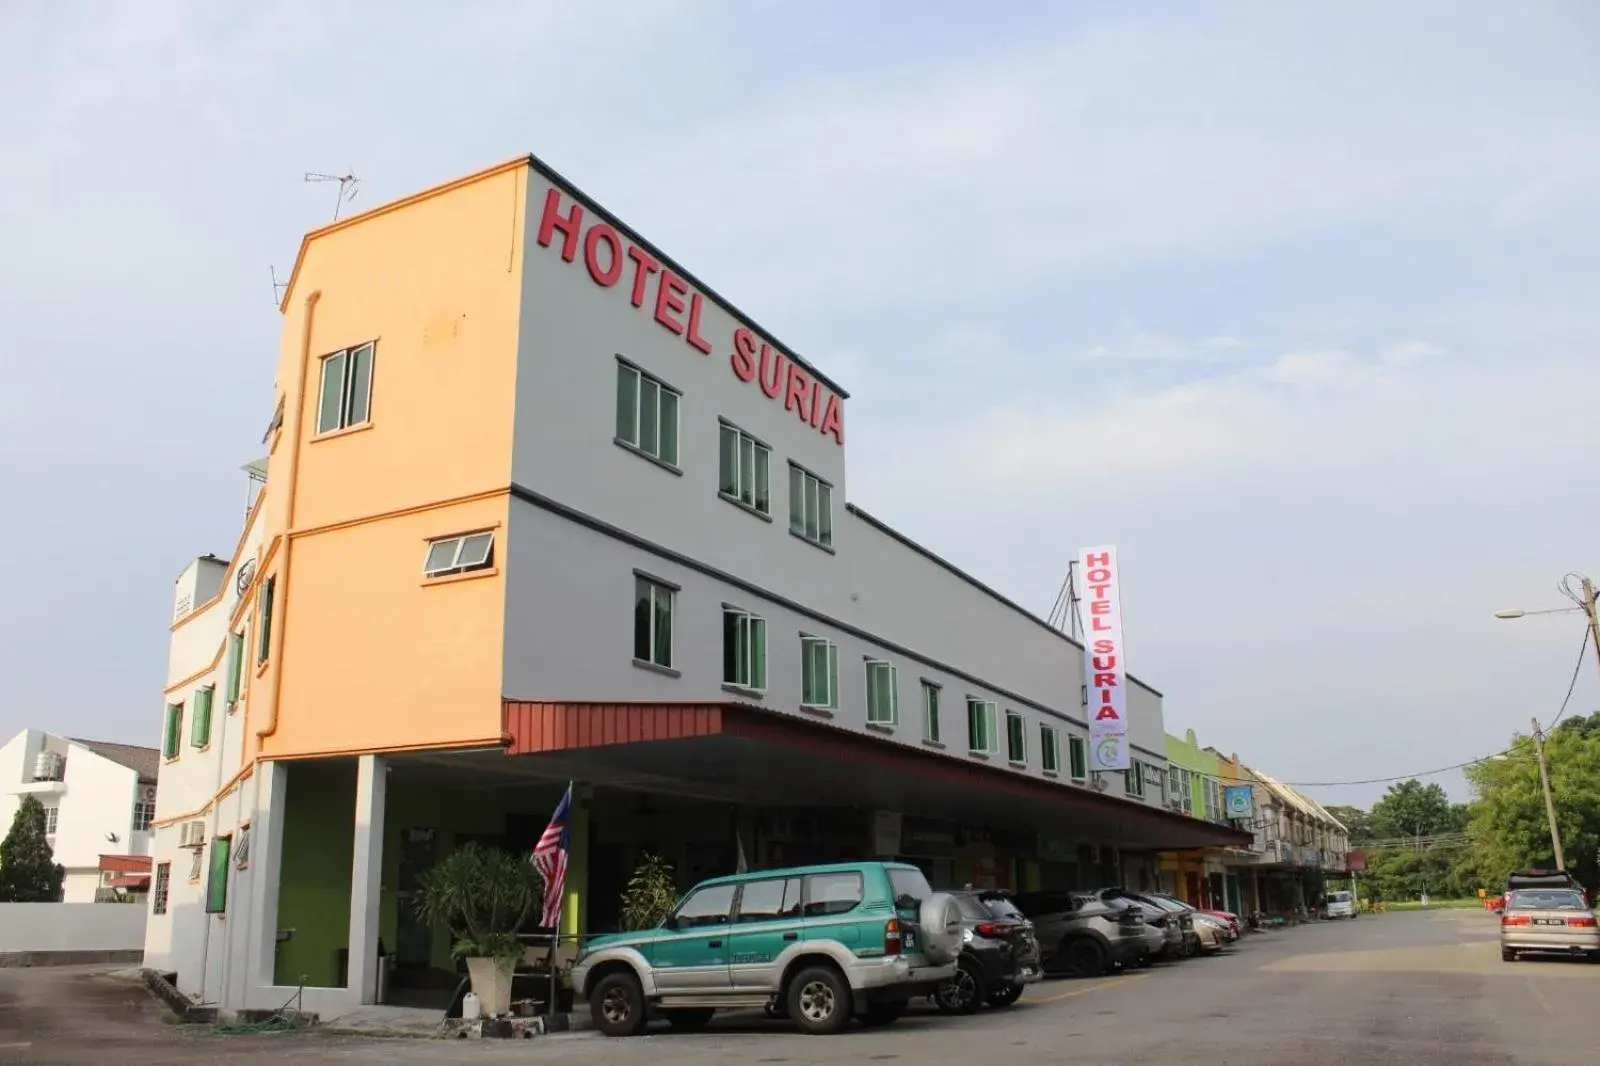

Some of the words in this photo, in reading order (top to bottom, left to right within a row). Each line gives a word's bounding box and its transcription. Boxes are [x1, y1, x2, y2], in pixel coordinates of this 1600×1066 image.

[536, 188, 712, 356] HOTEL
[730, 327, 845, 446] SURIA
[1086, 553, 1111, 631] HOTEL
[1093, 640, 1119, 720] SURIA
